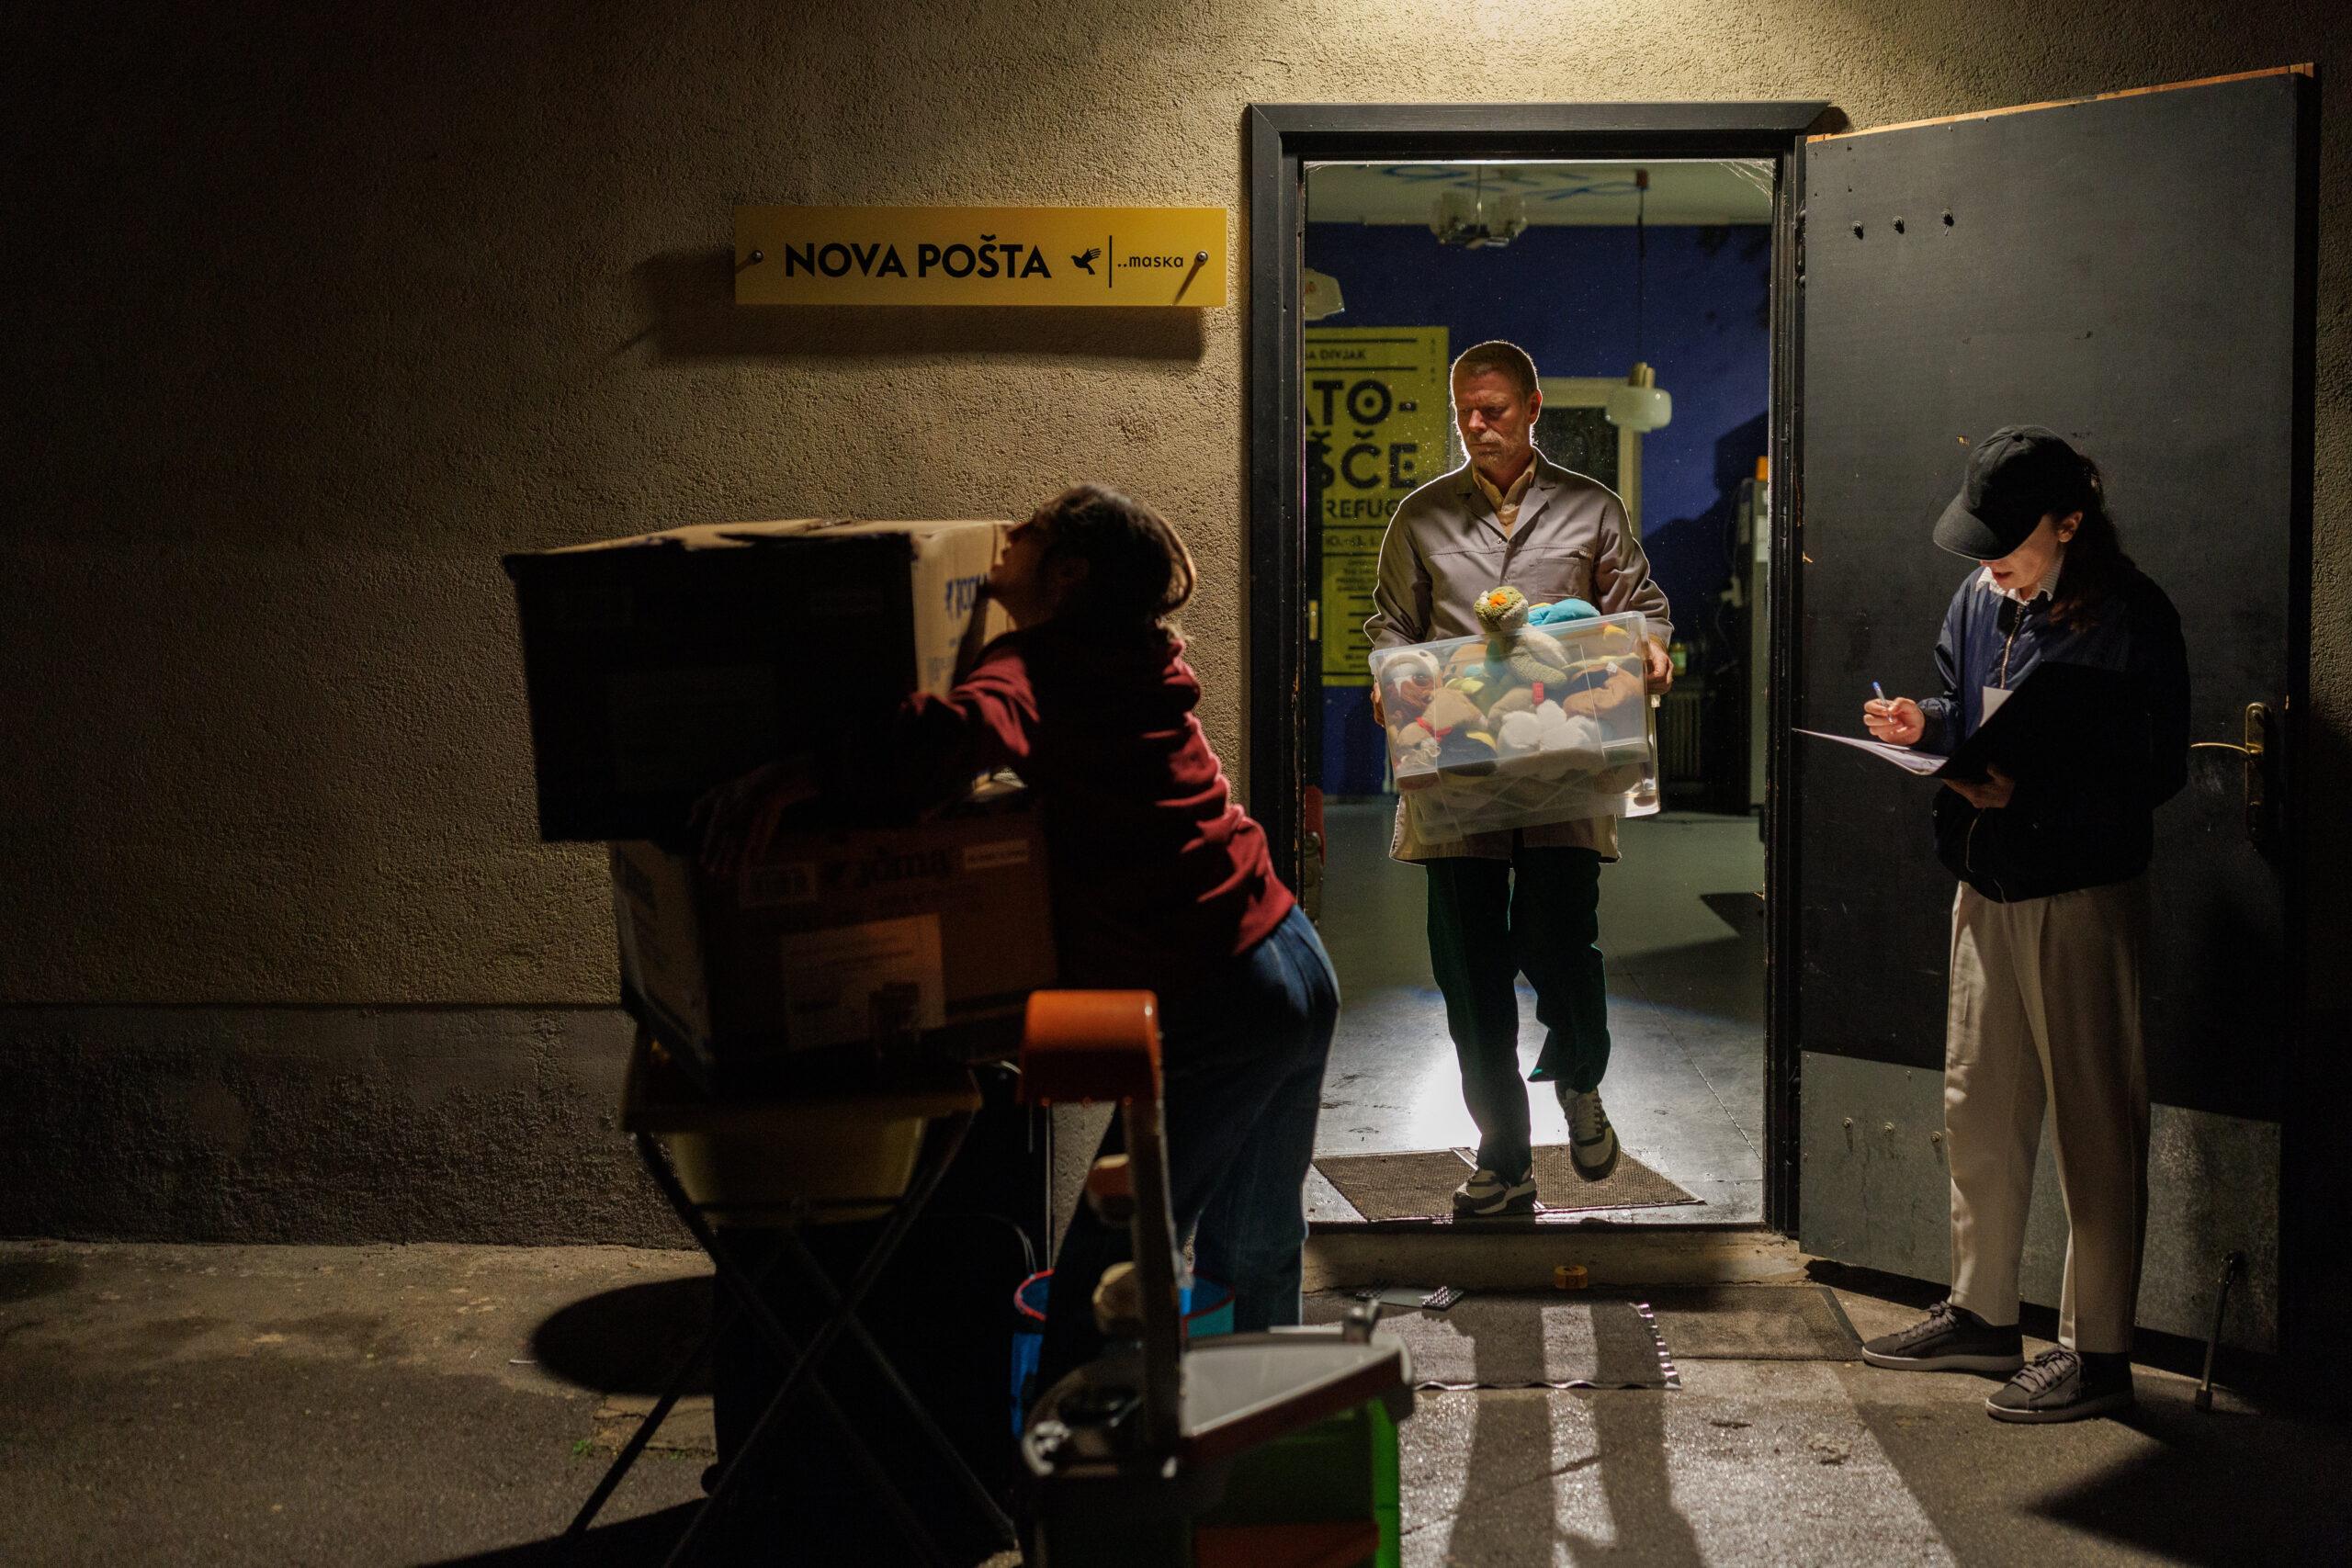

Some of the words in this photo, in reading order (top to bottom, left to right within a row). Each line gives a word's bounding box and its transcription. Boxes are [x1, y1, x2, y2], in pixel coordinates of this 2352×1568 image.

[785, 243, 908, 277] NOVA
[919, 233, 1052, 278] POŠTA
[1305, 378, 1418, 426] TO-
